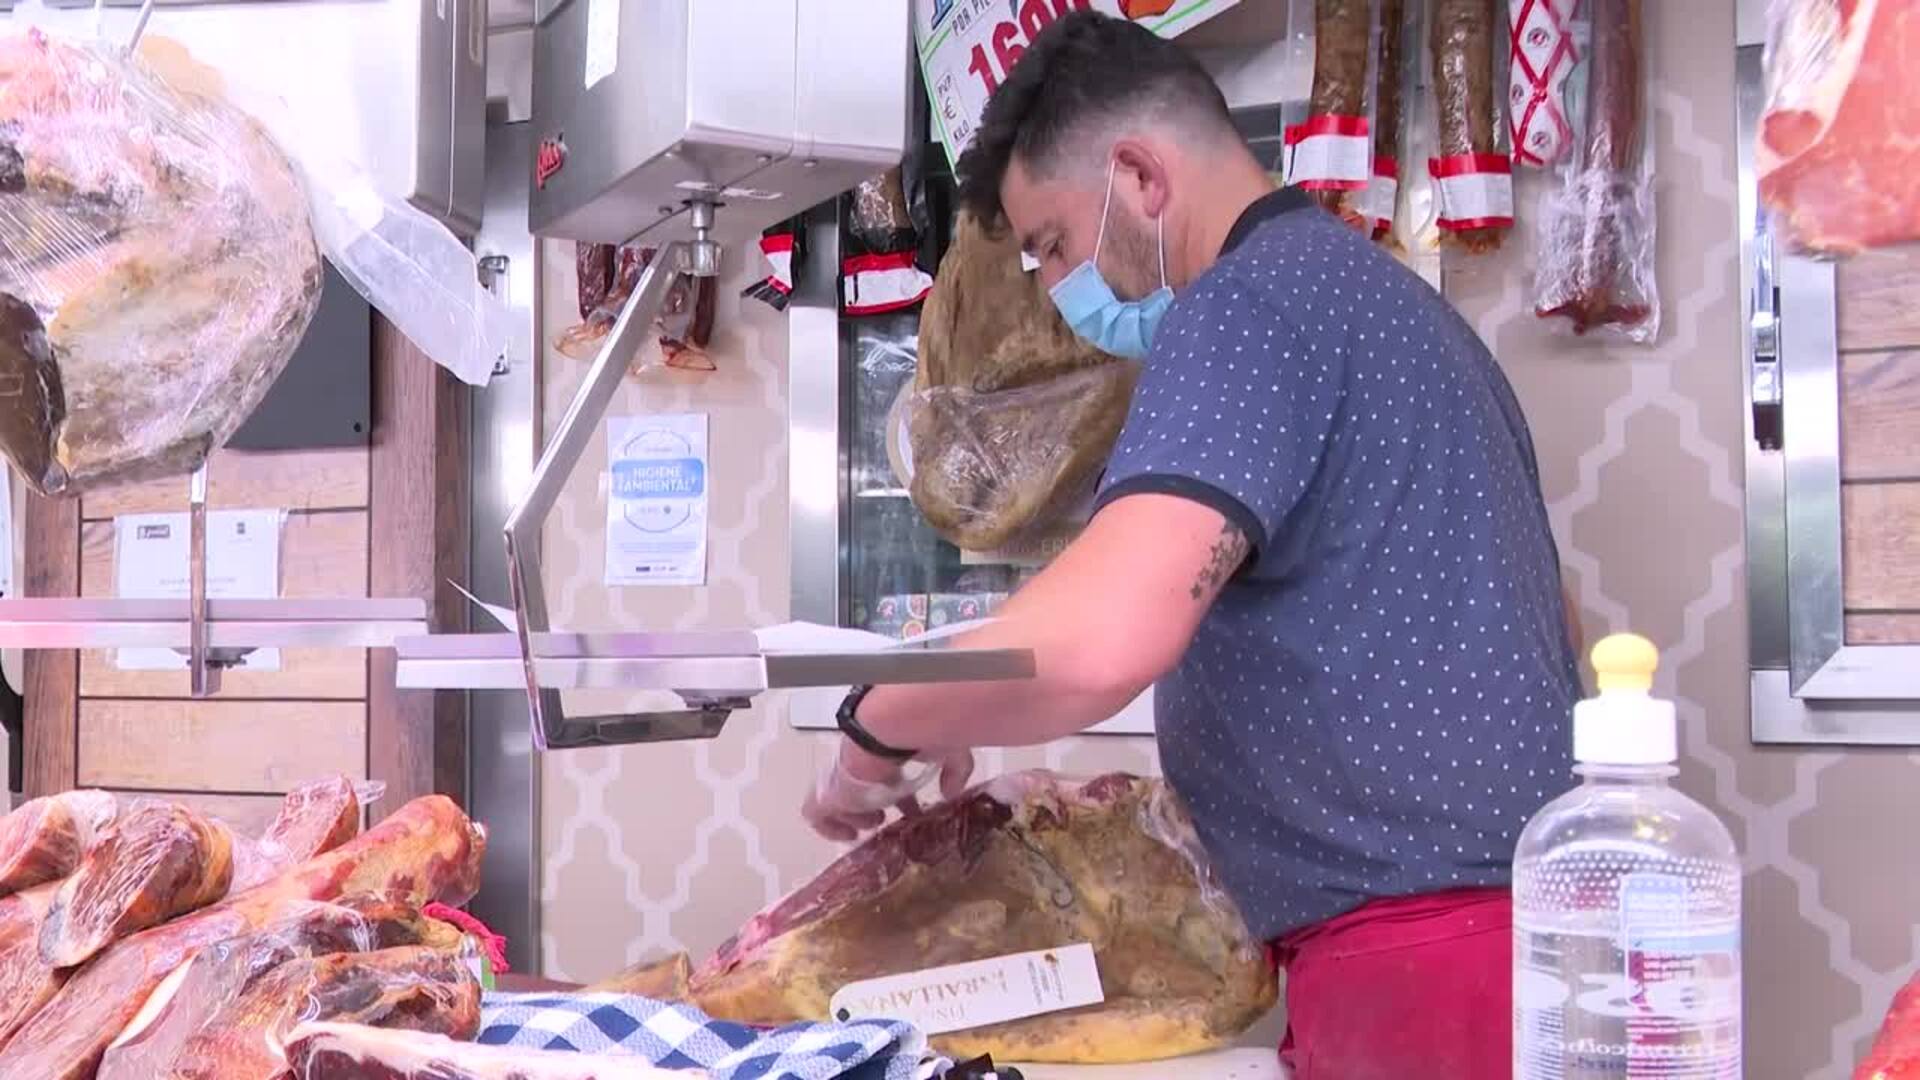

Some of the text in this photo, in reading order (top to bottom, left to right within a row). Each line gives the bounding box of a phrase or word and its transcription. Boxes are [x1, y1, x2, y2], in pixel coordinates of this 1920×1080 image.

[952, 7, 972, 37] POR
[953, 119, 970, 141] KILO
[633, 466, 682, 480] HIGIENE
[624, 479, 692, 493] AMBIENTAL
